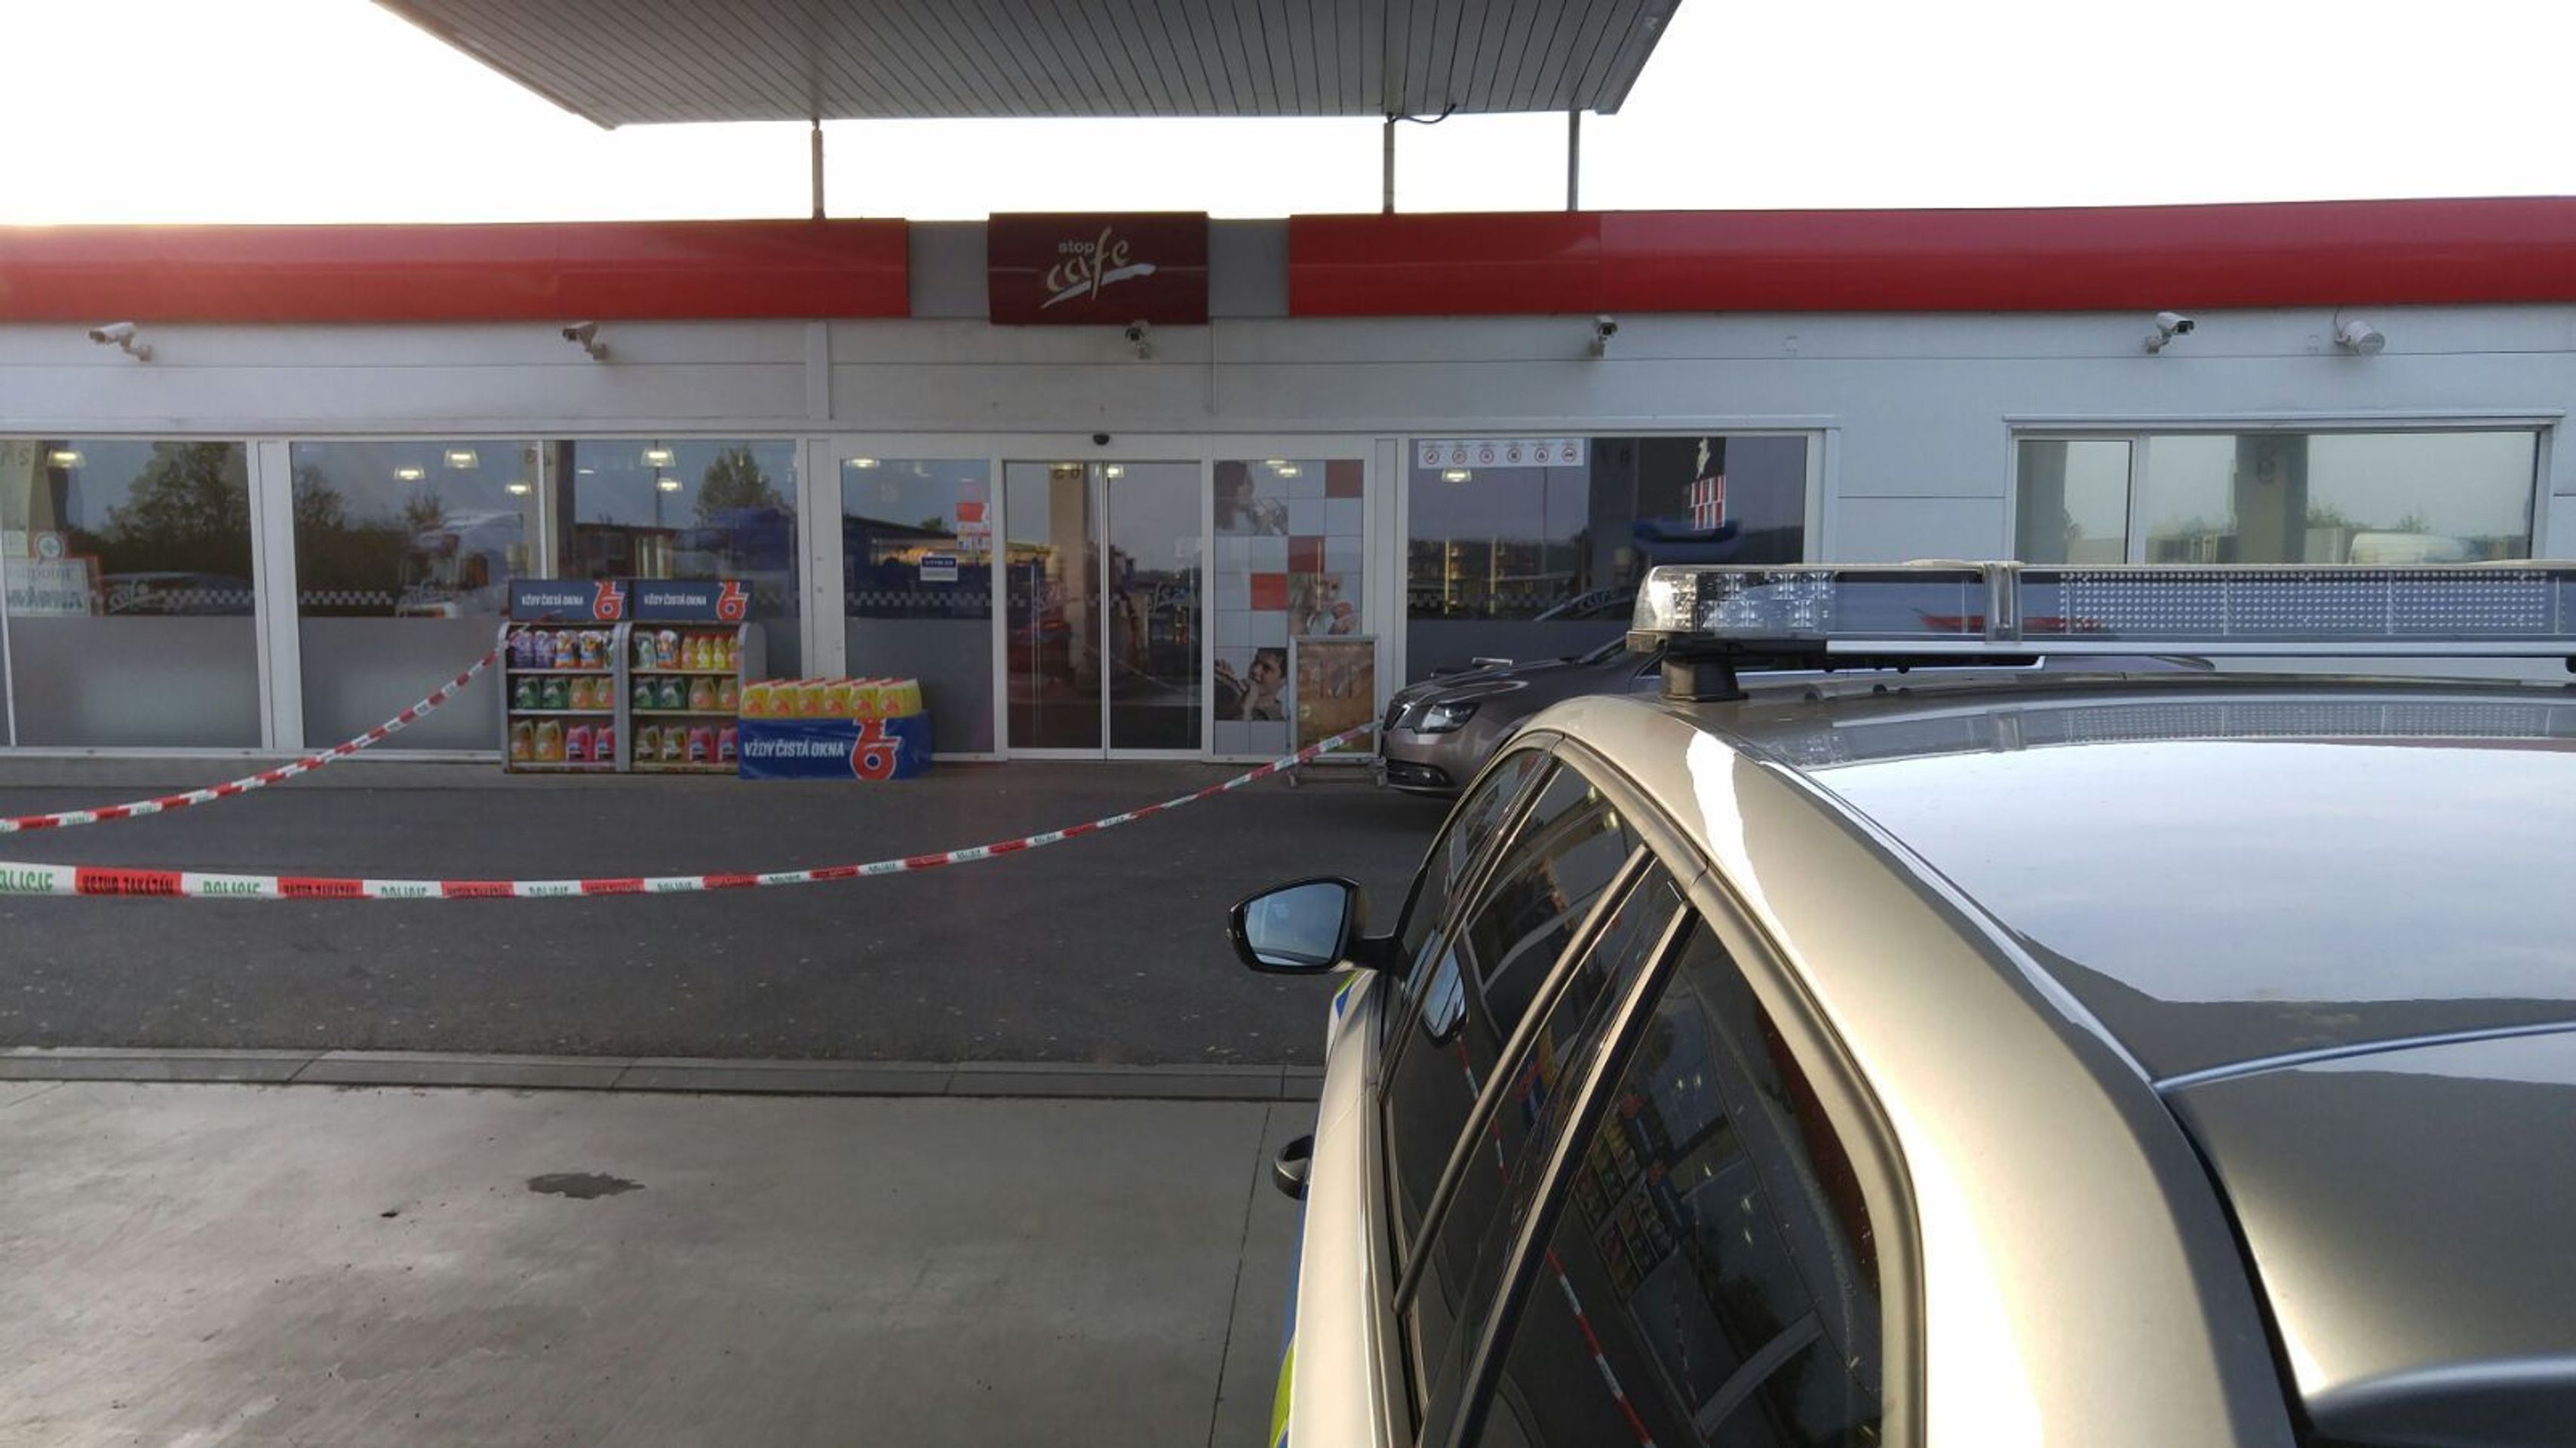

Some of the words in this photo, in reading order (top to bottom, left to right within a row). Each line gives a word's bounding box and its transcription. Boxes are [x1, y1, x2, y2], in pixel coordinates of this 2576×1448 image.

[1058, 239, 1095, 255] stop
[1047, 225, 1129, 301] cafe
[745, 738, 777, 757] VŽDY
[775, 738, 809, 757] ČISTÁ
[811, 741, 845, 757] OKNA
